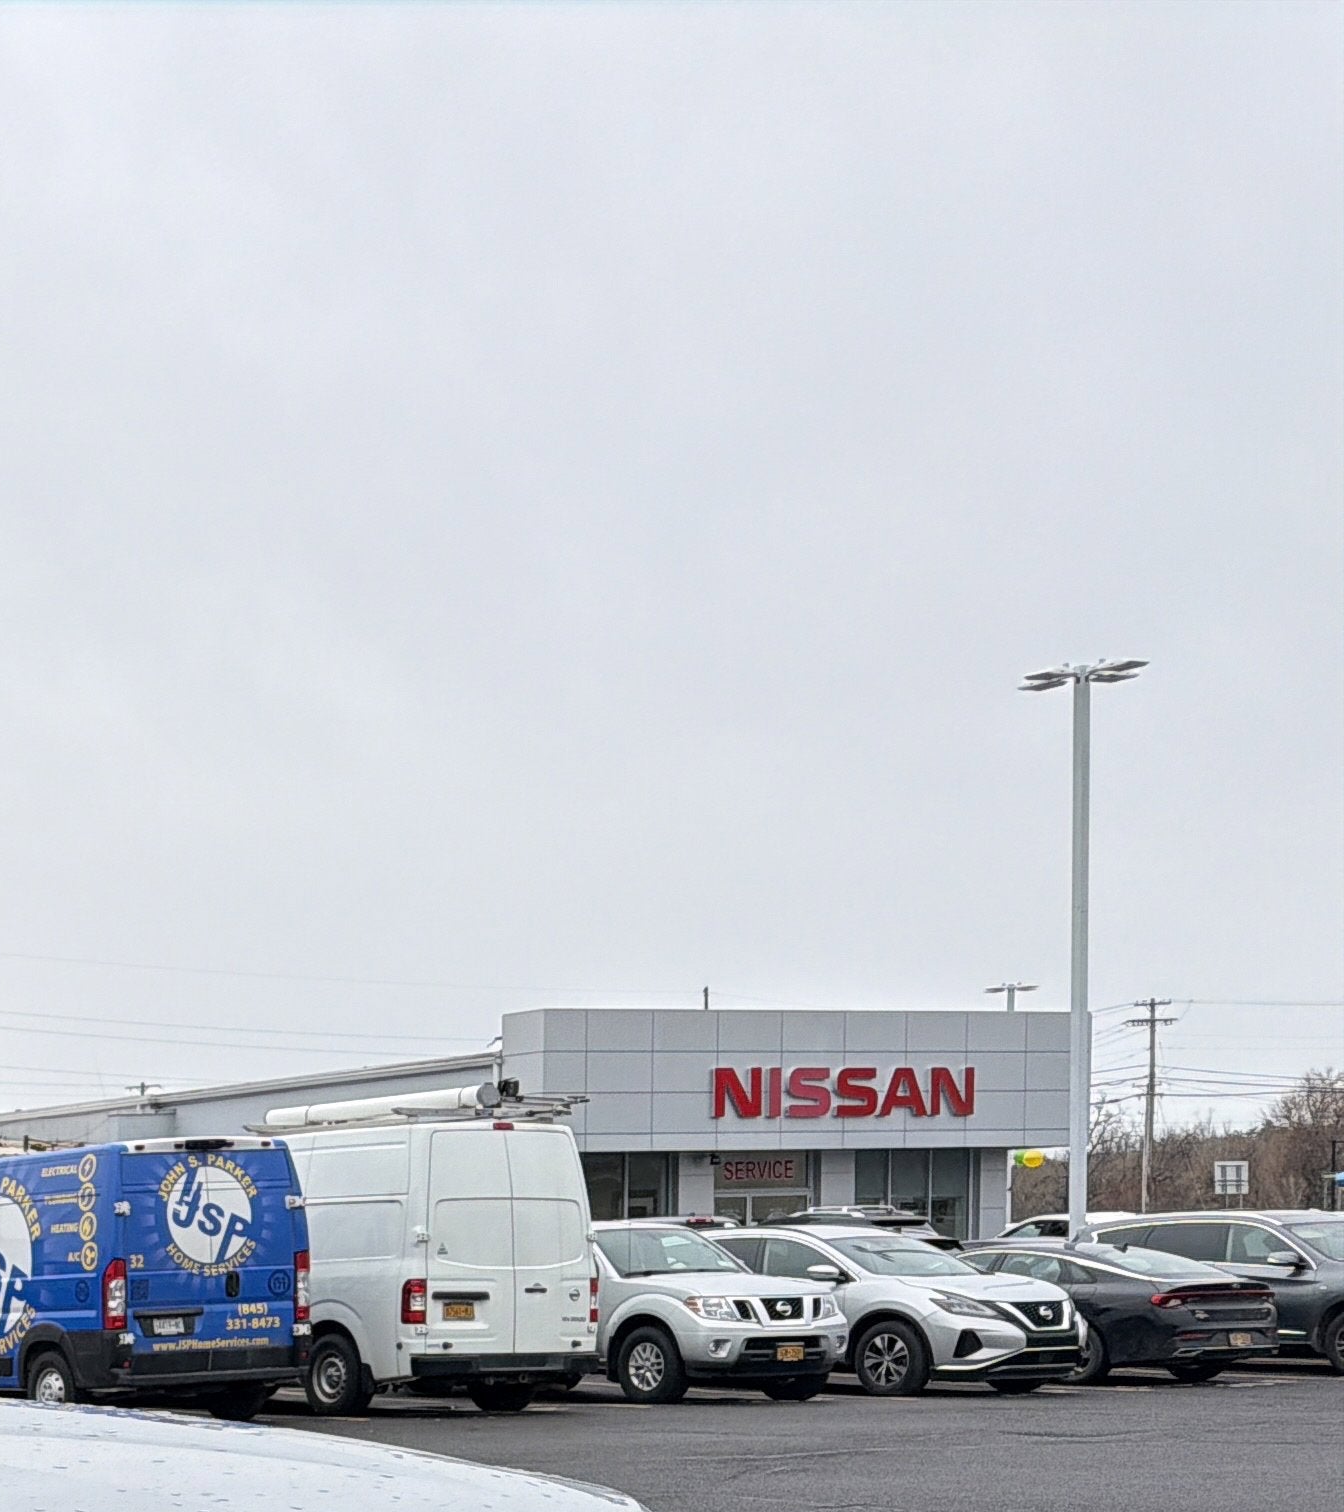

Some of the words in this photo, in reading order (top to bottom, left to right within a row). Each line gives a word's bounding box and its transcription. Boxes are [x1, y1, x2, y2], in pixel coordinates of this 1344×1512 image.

[712, 1066, 976, 1119] NISSAN
[158, 1162, 187, 1202] JOHN
[187, 1155, 203, 1168] S.
[207, 1153, 258, 1199] PARKER
[723, 1160, 794, 1181] SERVICE
[0, 1176, 42, 1242] PARKER
[172, 1180, 252, 1263] JSP
[129, 1254, 145, 1269] 32
[165, 1243, 202, 1275] HOME
[202, 1238, 257, 1277] SERVICES
[225, 1316, 281, 1331] 331-8473
[237, 1303, 269, 1316] (845)
